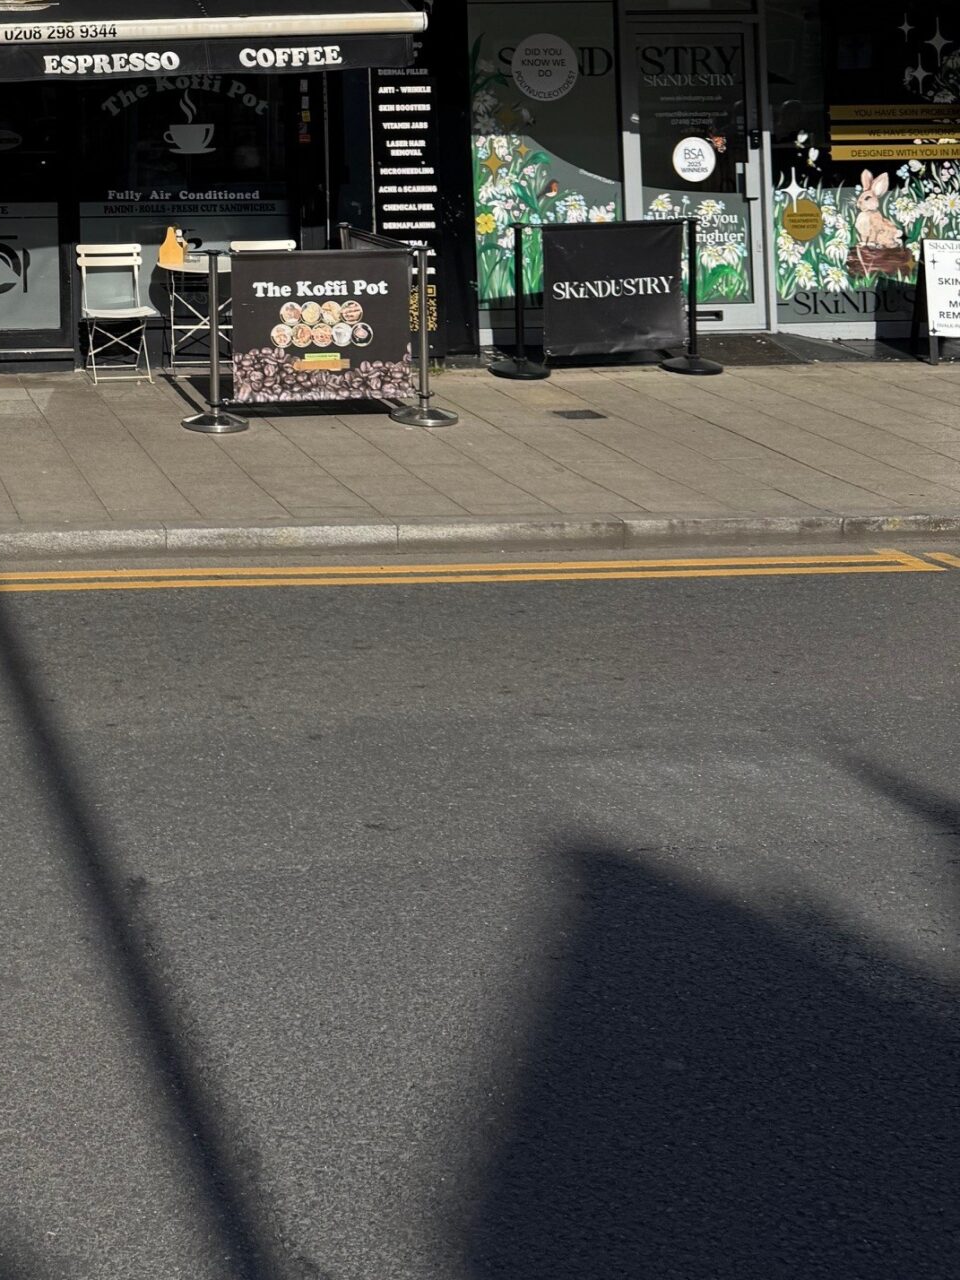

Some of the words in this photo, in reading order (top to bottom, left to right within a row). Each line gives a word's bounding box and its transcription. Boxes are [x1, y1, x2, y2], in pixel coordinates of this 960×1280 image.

[46, 26, 75, 40] 298
[80, 24, 117, 38] 9344
[239, 45, 343, 68] COFFEE
[525, 48, 541, 56] DID
[542, 48, 562, 56] YOU
[43, 51, 180, 74] ESPRESSO
[521, 59, 550, 67] KNOW
[552, 59, 567, 67] WE
[515, 70, 577, 99] POLYNUCLEOTIDES?
[100, 83, 149, 117] The
[155, 74, 222, 93] Koffi
[226, 80, 270, 116] Pot
[855, 109, 873, 117] YOU
[683, 148, 705, 160] BSA
[896, 149, 917, 157] WITH
[380, 167, 434, 175] MICRONEEDLING
[107, 190, 142, 201] Fully
[149, 190, 172, 200] Air
[179, 189, 260, 200] Conditioned
[104, 205, 134, 214] PANINI
[139, 205, 166, 213] ROLLS
[171, 204, 199, 213] FRESH
[200, 204, 217, 212] CUT
[219, 203, 276, 212] SANDWICHES
[712, 214, 738, 228] you
[696, 230, 744, 246] righter
[252, 281, 292, 298] The
[295, 280, 349, 297] Koffi
[352, 279, 389, 296] Pot
